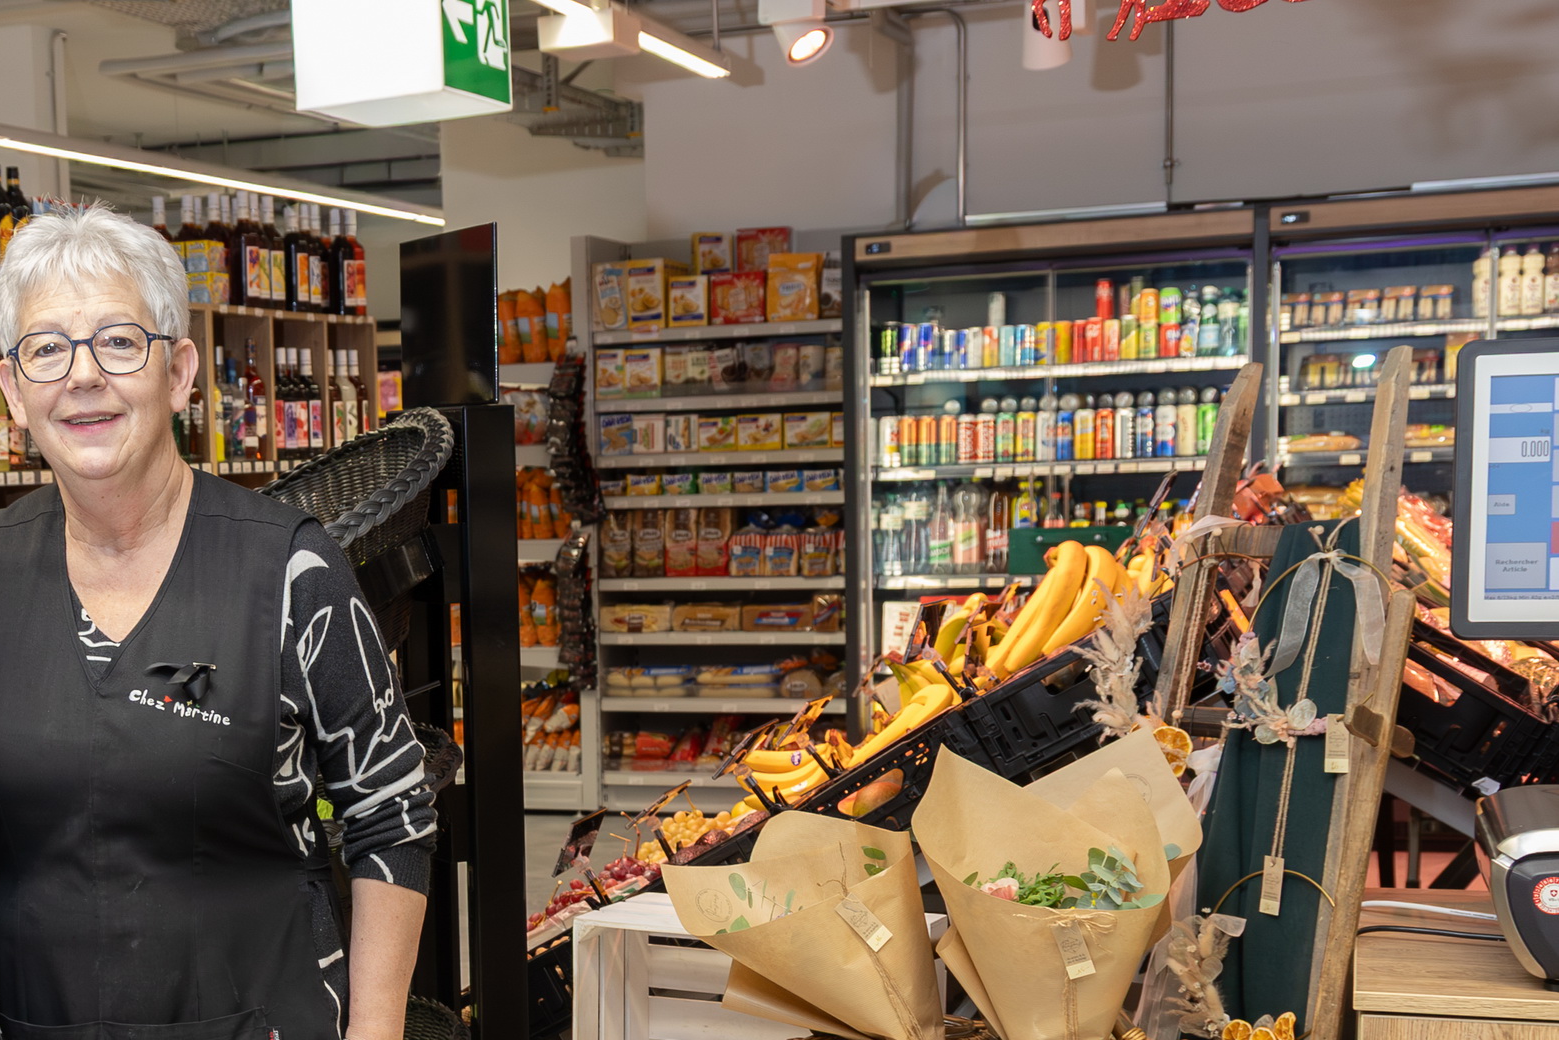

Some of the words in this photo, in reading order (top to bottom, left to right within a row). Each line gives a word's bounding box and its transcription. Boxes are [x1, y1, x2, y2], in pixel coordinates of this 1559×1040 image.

[1521, 440, 1549, 457] 0.000
[129, 689, 165, 711] Chez
[173, 702, 230, 726] Martine
